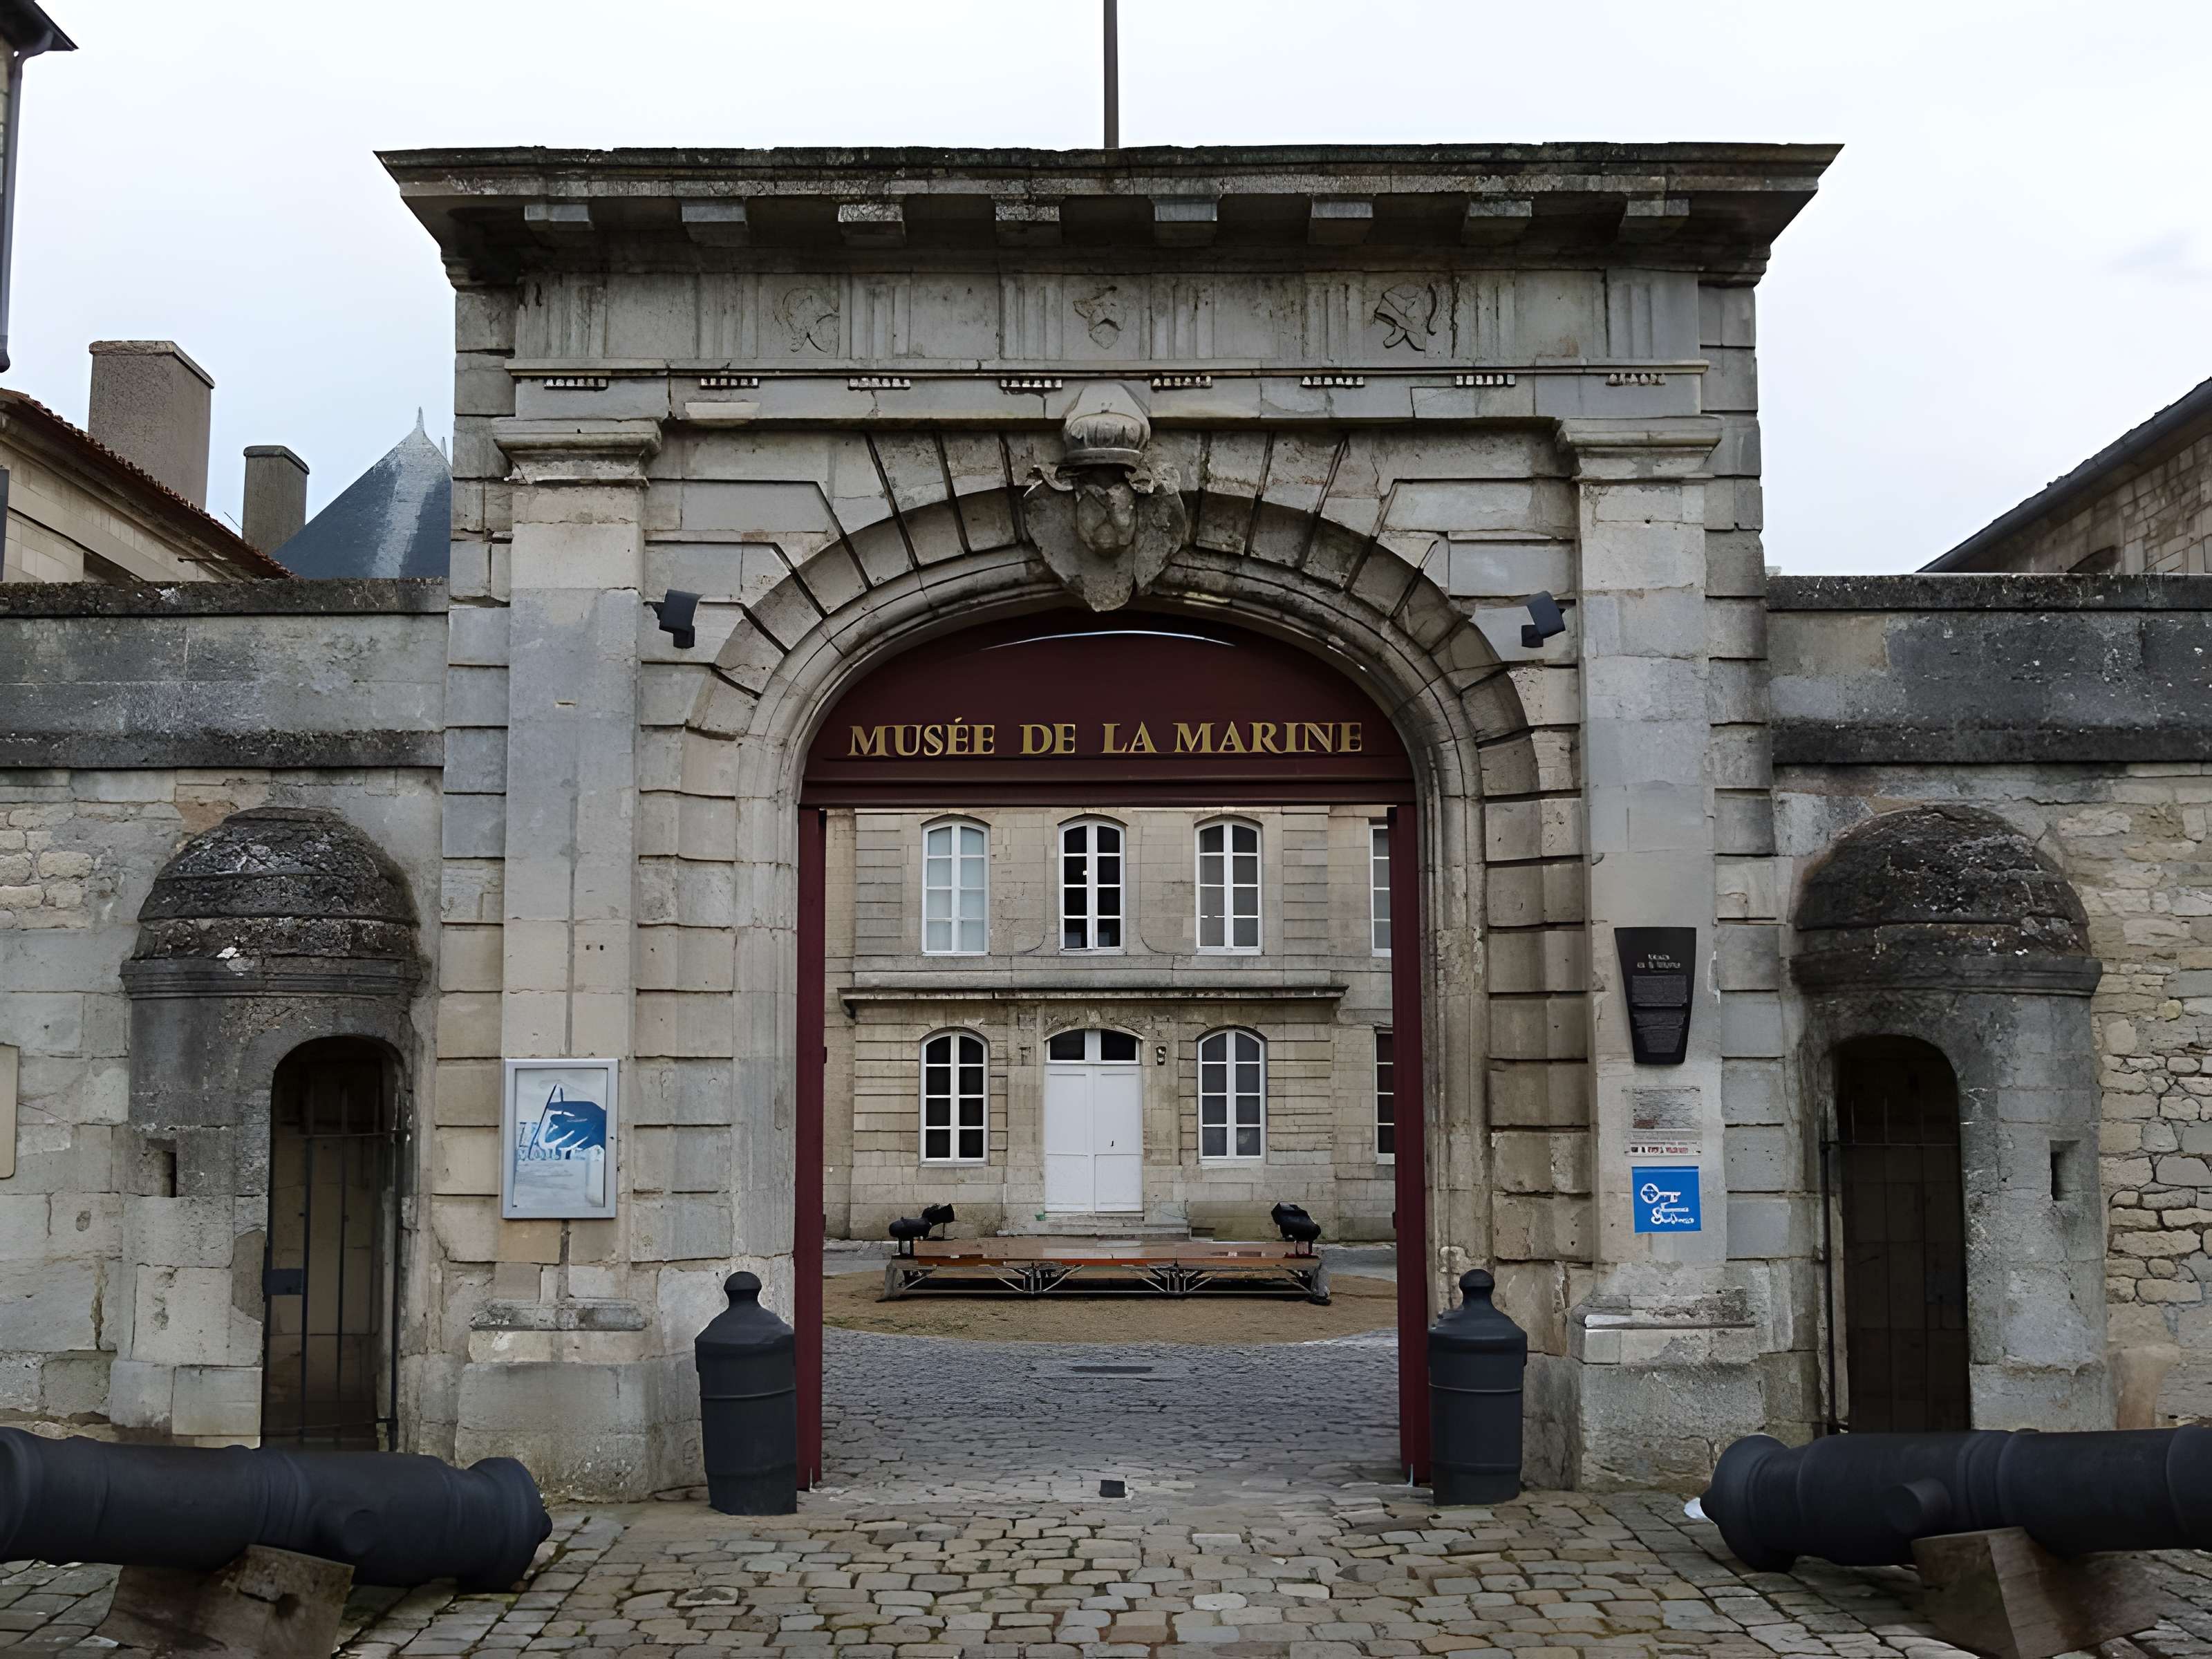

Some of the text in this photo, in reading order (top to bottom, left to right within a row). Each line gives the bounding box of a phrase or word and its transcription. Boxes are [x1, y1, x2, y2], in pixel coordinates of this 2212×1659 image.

[847, 716, 1362, 757] MUSÉE DE LA MARINE
